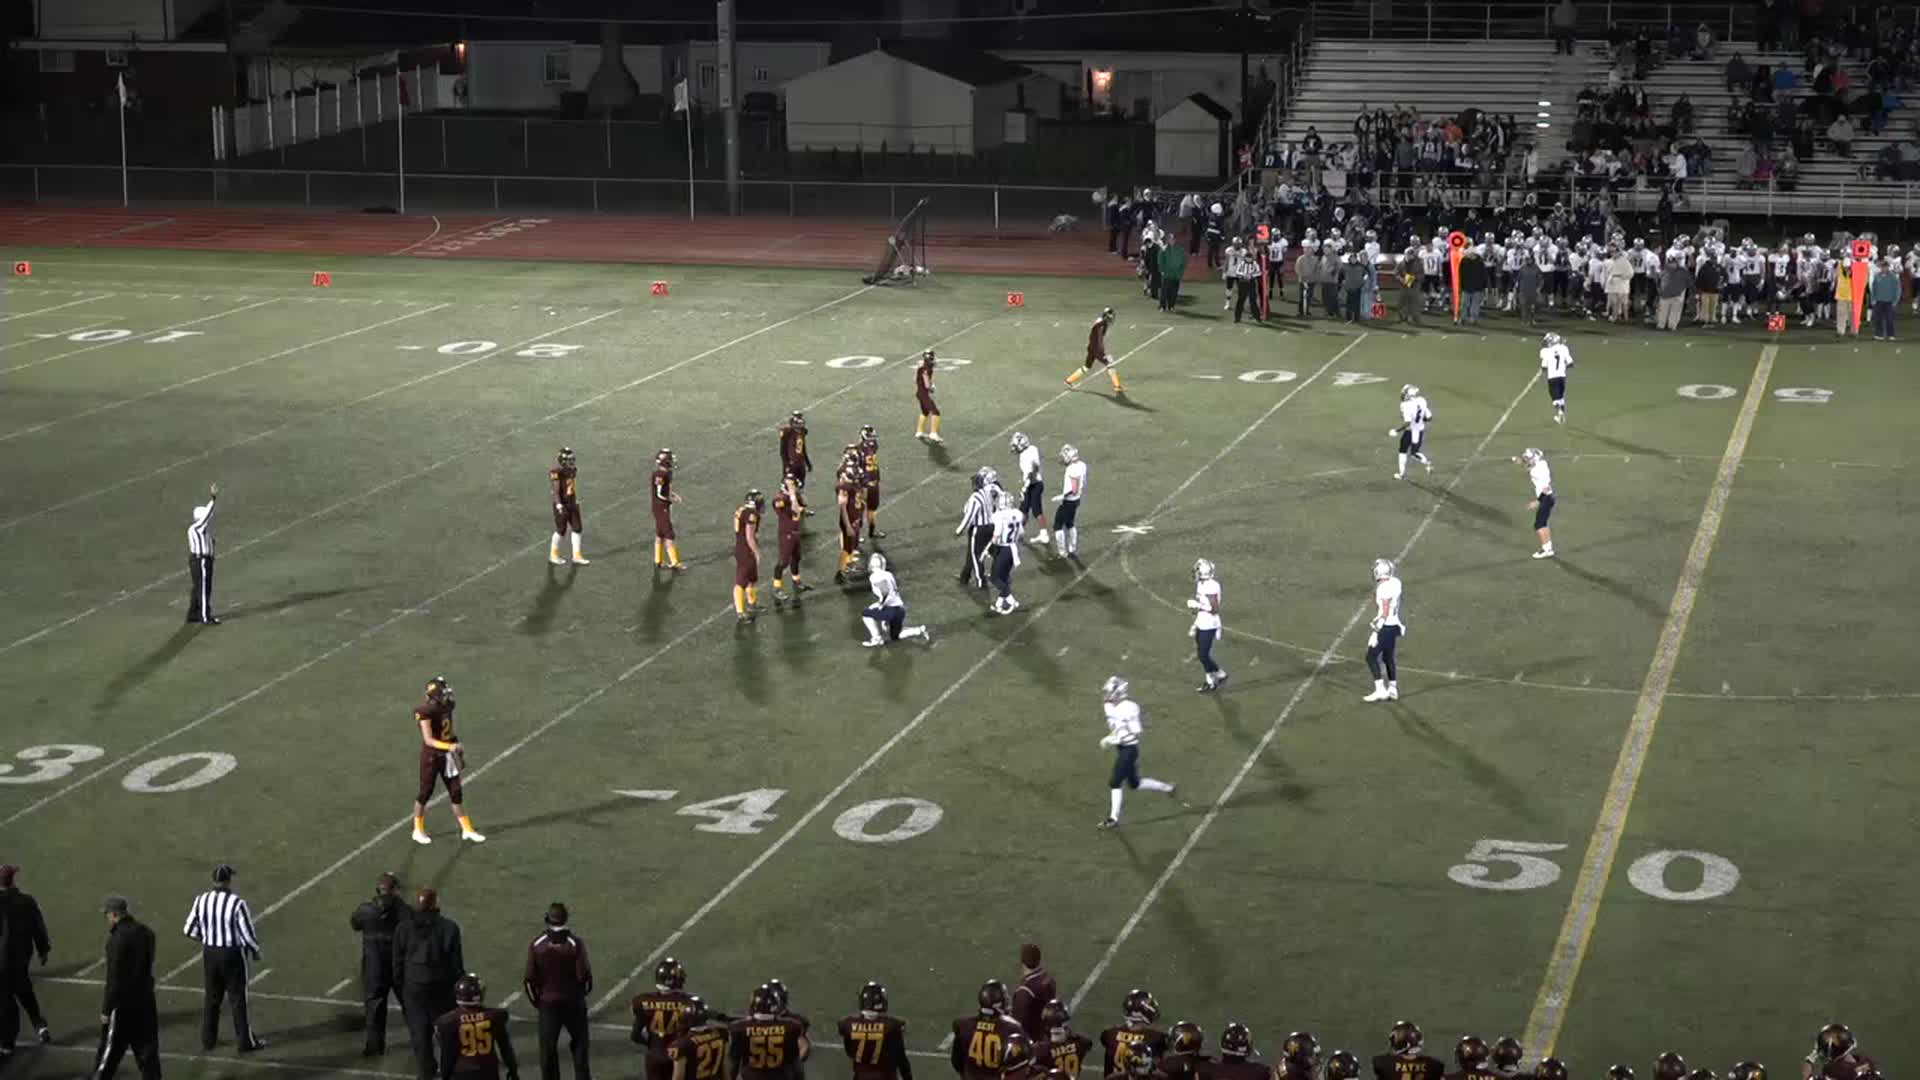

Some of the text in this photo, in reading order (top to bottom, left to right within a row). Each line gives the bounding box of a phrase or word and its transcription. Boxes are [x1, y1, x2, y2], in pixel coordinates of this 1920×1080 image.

[1257, 224, 1270, 241] 3
[16, 263, 26, 273] G
[459, 1021, 492, 1057] 95
[746, 1026, 785, 1037] FLOWERS
[851, 1022, 885, 1033] WALLER
[695, 1041, 725, 1079] 27
[750, 1036, 784, 1060] 55
[851, 1032, 885, 1065] 77
[968, 1031, 1001, 1068] 40
